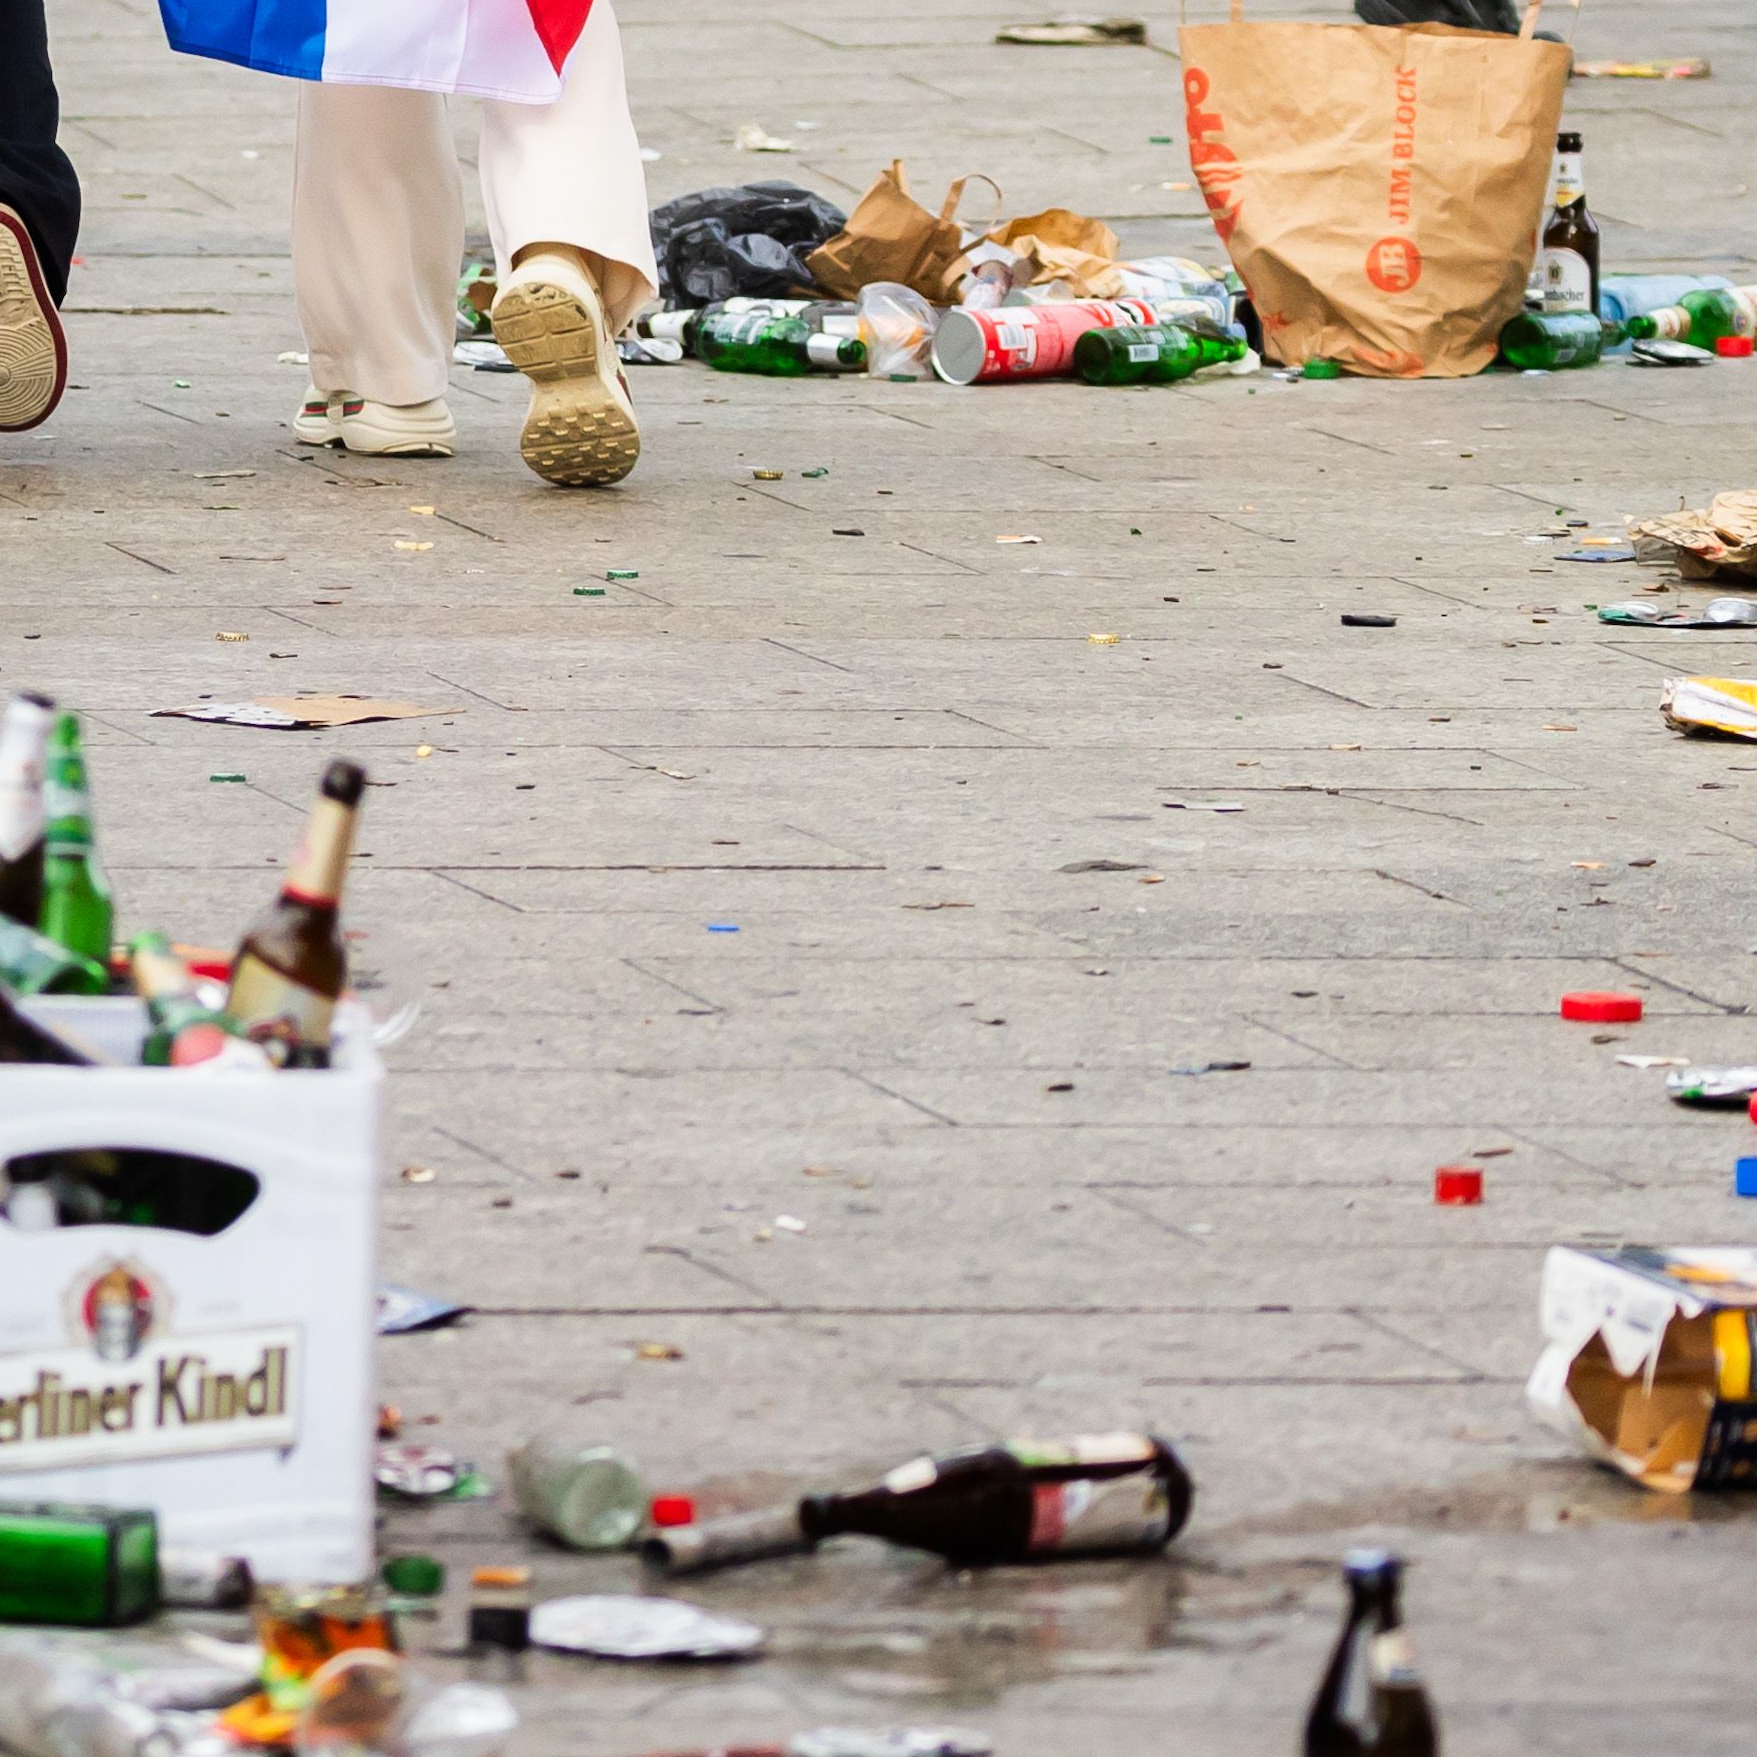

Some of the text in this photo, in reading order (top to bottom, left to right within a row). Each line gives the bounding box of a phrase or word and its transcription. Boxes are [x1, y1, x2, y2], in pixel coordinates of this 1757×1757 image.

[1389, 65, 1417, 225] JIM BLOCK
[155, 1346, 288, 1427] Kindl
